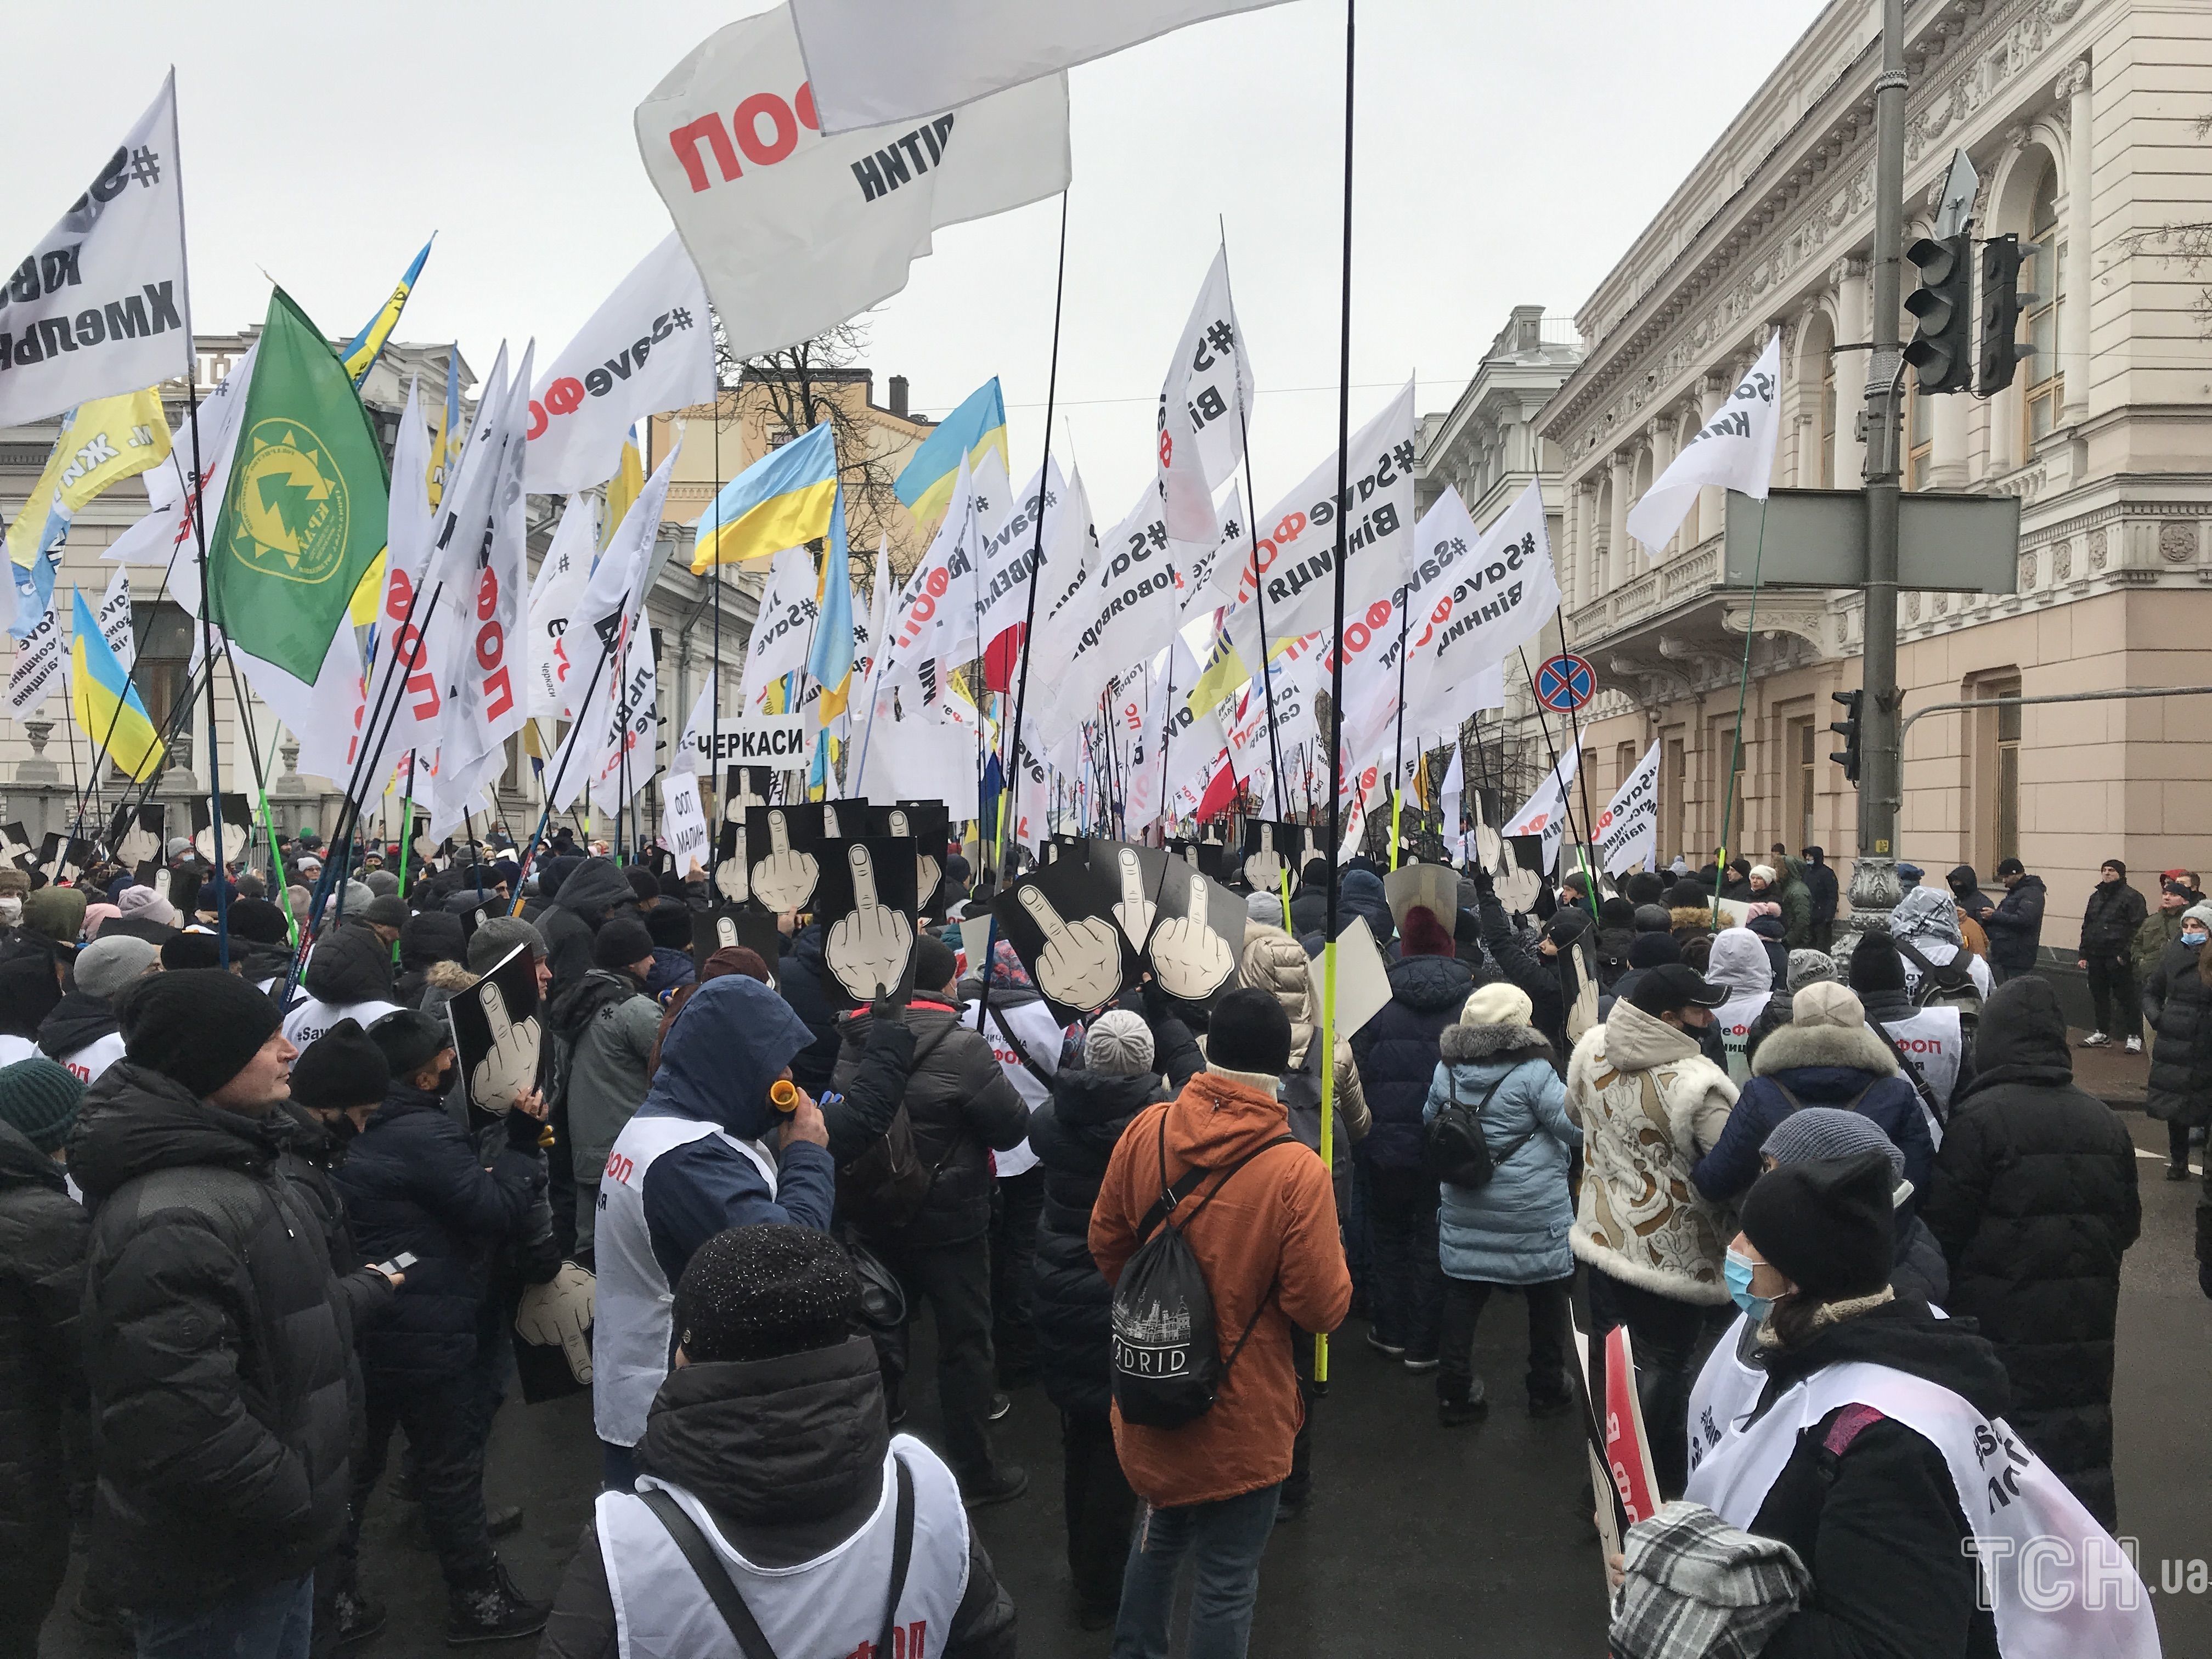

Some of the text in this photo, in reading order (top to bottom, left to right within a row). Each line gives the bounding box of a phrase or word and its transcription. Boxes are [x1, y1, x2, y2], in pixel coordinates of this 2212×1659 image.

[696, 728, 803, 760] ЧЕРКАСИ
[674, 790, 694, 818] ФОП
[676, 822, 704, 856] МАЛИН
[61, 1059, 91, 1085] ОП
